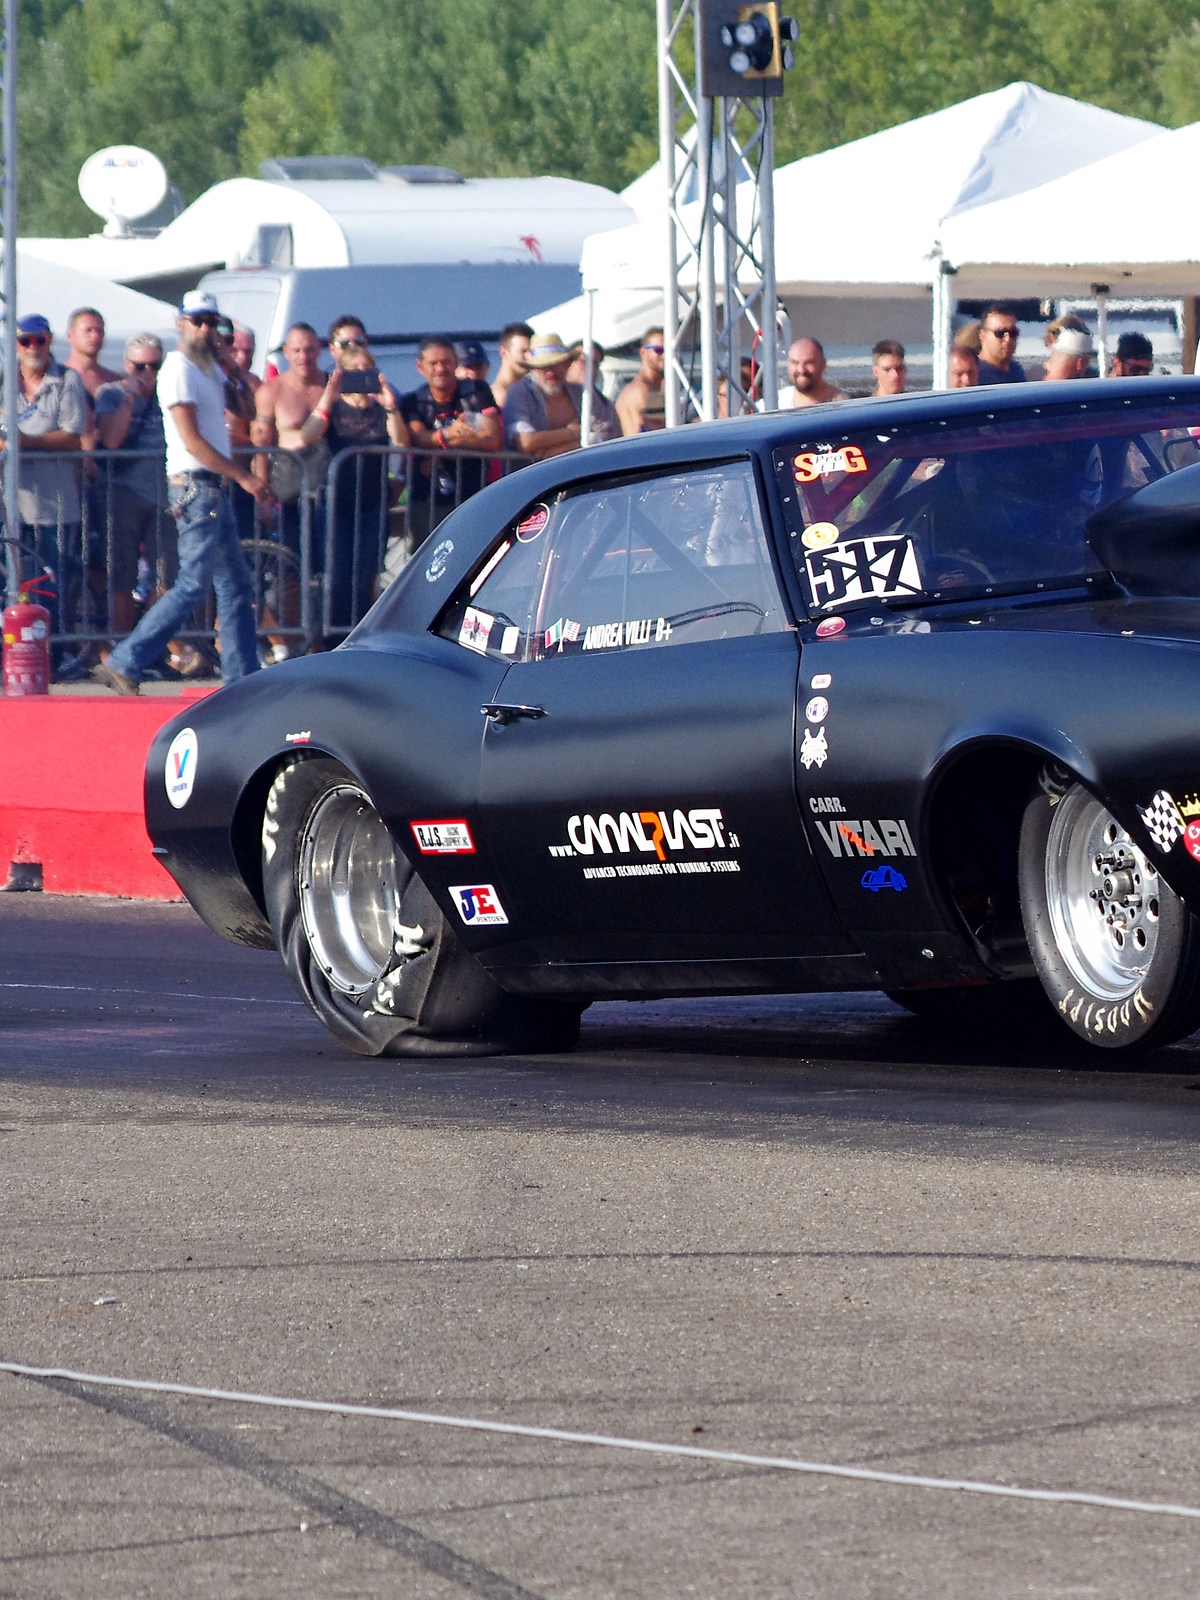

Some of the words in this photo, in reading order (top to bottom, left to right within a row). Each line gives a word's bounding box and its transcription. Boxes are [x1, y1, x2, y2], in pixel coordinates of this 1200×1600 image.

[582, 622, 623, 650] ANDREA
[625, 618, 652, 645] VILLI
[655, 617, 673, 642] B+
[809, 797, 846, 813] CARR.
[815, 819, 917, 858] VITARI
[583, 866, 616, 880] ADVANCED
[615, 863, 664, 877] TECHNOLOGIES
[662, 862, 678, 875] FOR
[676, 861, 711, 874] TRUNKING
[710, 860, 741, 872] SYSTEMS
[460, 887, 498, 922] JE
[475, 915, 506, 923] PISTONS
